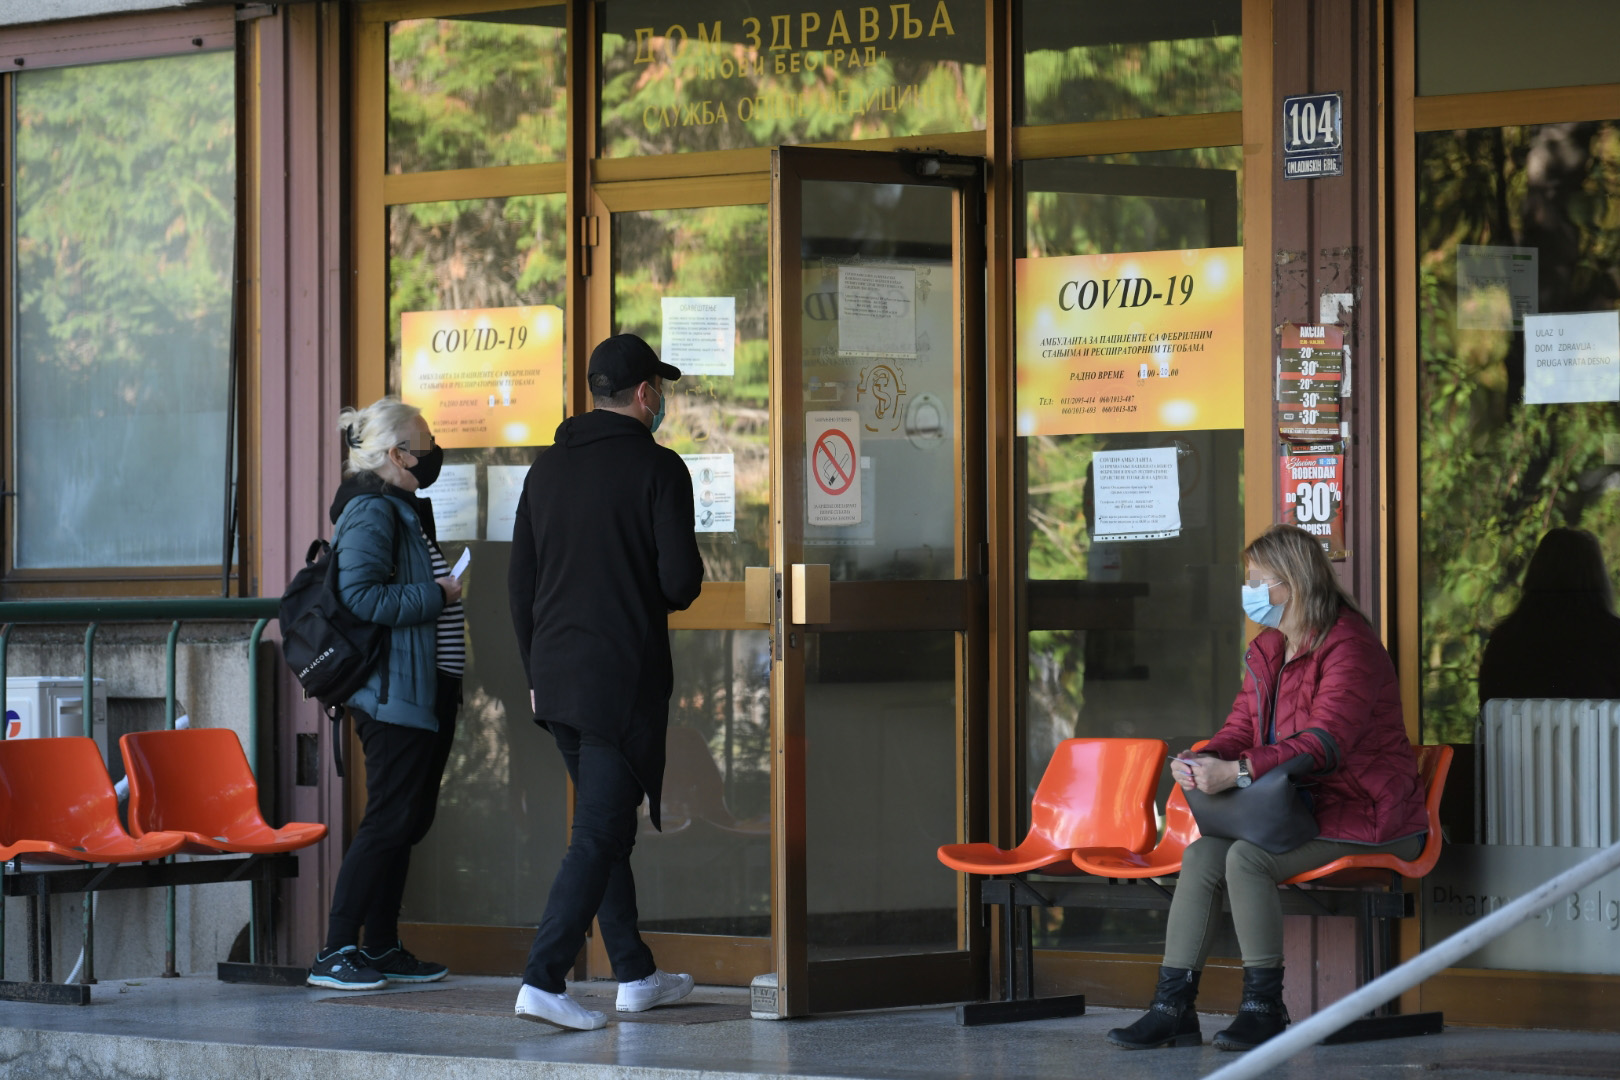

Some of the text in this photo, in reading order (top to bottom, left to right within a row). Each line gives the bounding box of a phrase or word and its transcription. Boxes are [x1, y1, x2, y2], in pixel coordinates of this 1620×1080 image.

[634, 0, 955, 65] ДОМ ЗДРАВЉА
[643, 100, 728, 130] СЛУЖБА
[737, 94, 807, 122] ОПШТЕ
[1289, 100, 1334, 146] 104
[1058, 274, 1194, 312] COVID-19
[432, 325, 527, 353] COVID-19
[1040, 330, 1213, 347] АМБУЛАНТА ЗА ПАЦИЈЕНТЕ СА ФЕБРИЛНИМ
[1300, 326, 1325, 338] AKCIJA
[1535, 328, 1564, 337] ULAZ U
[1042, 343, 1204, 359] СТАЊИМА И РЕСПИРАТОРНИМ ТЕГОБАМА
[1535, 344, 1553, 353] DOM
[1558, 342, 1592, 352] ZDRAVLJA
[1536, 356, 1611, 368] DRUGA VRATA DESNO
[1070, 371, 1097, 381] РАДНО
[1098, 370, 1125, 380] ВРЕМЕ
[1285, 482, 1341, 522] DO 30%
[310, 647, 335, 670] JACOBS
